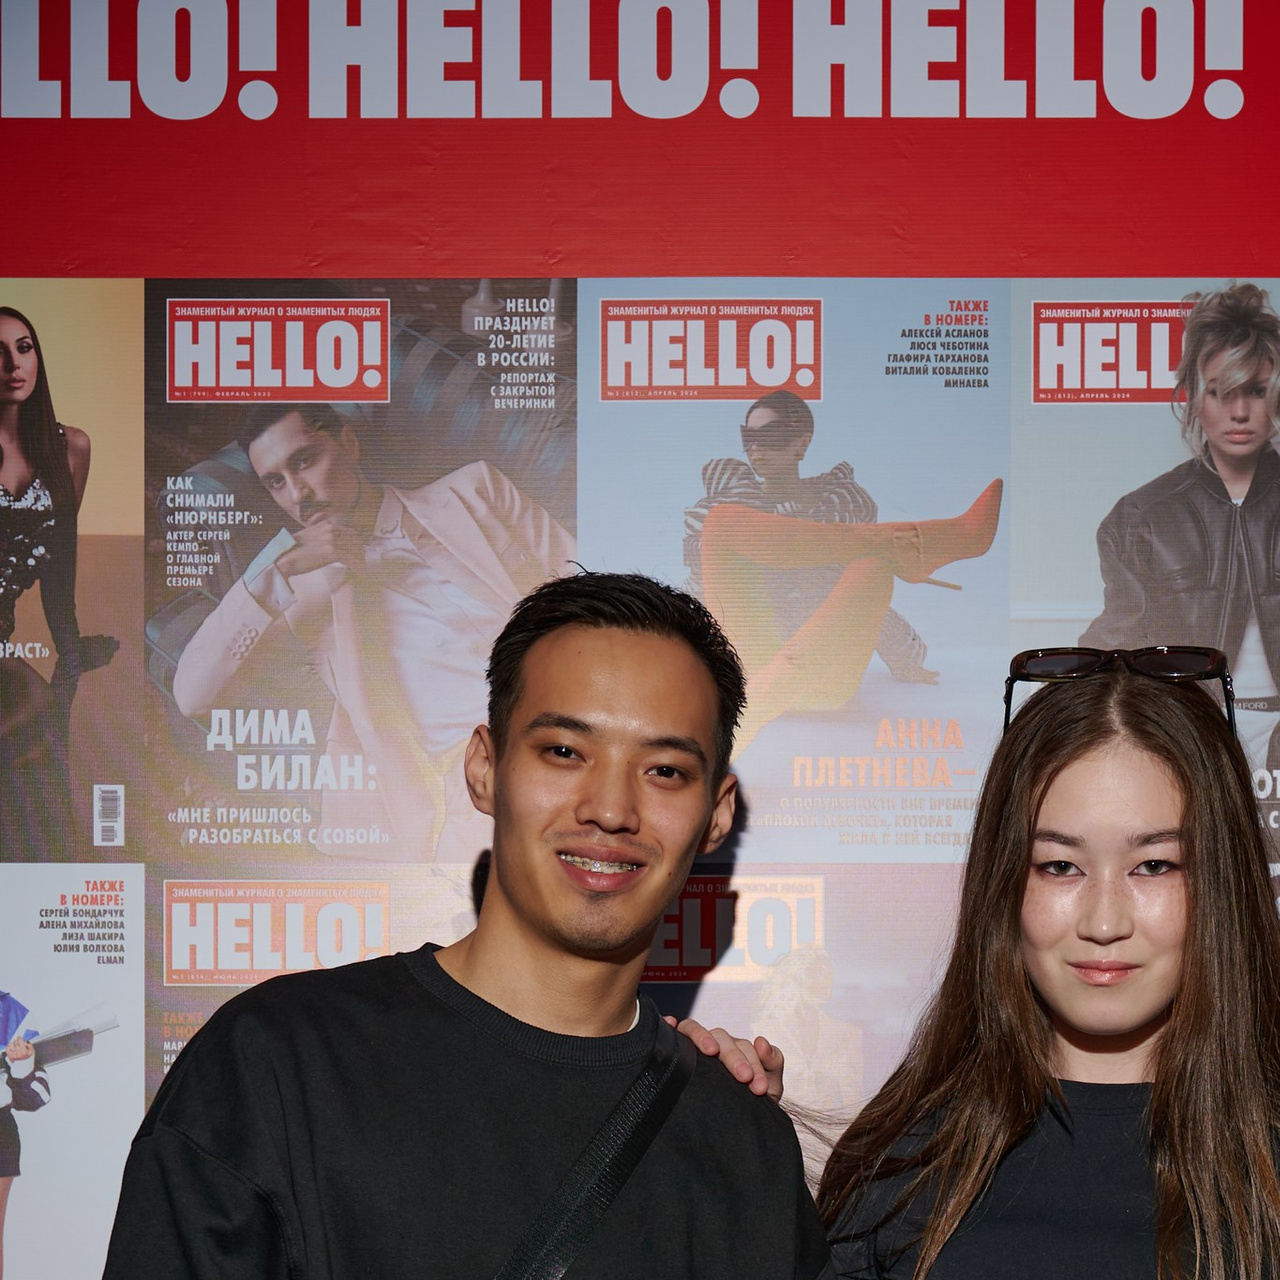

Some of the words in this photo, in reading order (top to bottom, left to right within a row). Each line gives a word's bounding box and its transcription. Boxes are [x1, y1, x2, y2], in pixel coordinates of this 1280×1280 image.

[308, 0, 762, 120] HELLO!
[792, 0, 1245, 120] HELLO!
[175, 305, 236, 317] ЗНАМЕНИТЫЙ
[237, 307, 276, 317] ЖУРНАЛ
[286, 306, 346, 317] ЗНАМЕНИТЫХ
[348, 306, 381, 318] ЛЮДЯХ
[506, 298, 555, 312] HELLO!
[949, 300, 989, 312] ТАКЖЕ
[1040, 307, 1101, 318] ЗНАМЕНИТЫЙ
[1102, 308, 1141, 318] ЖУРНАЛ
[1151, 308, 1193, 318] ЗНАМЕНИ
[474, 317, 555, 333] ПРАЗДНУЕТ
[900, 327, 943, 338] АЛЕКСЕЙ
[945, 328, 989, 338] АСЛАНОВ
[488, 335, 555, 348] 20-ЛЕТИЕ
[910, 341, 938, 351] ЛЮСЯ
[940, 341, 989, 351] ЧЕБОТИНА
[174, 320, 382, 388] HELLO!
[477, 353, 486, 366] В
[491, 353, 555, 366] РОССИИ:
[607, 319, 815, 387] HELLO!
[887, 353, 932, 363] ГЛАФИРА
[934, 353, 989, 363] ТАРХАНОВА
[885, 365, 929, 376] ВИТАЛИЙ
[932, 366, 989, 376] КОВАЛЕНКО
[500, 373, 555, 384] РЕПОРТАЖ
[944, 379, 989, 388] МИНАЕВА
[494, 398, 555, 409] ВЕЧЕРИНКИ
[166, 477, 193, 490] КАК
[166, 494, 235, 507] СНИМАЛИ
[166, 511, 263, 525] «НЮРНБЕРГ»:
[166, 531, 195, 541] АКТЕР
[198, 529, 230, 541] СЕРГЕЙ
[166, 543, 199, 552] КЕМПО
[166, 565, 213, 575] ПРЕМЬЕРЕ
[166, 577, 202, 587] СЕЗОНА
[206, 709, 315, 751] ДИМА
[874, 718, 964, 749] АННА
[236, 754, 377, 790] БИЛАН:
[168, 807, 210, 823] «МНЕ
[216, 807, 311, 823] ПРИШЛОСЬ
[189, 828, 301, 844] РАЗОБРАТЬСЯ
[323, 826, 390, 844] СОБОЙ»
[39, 907, 70, 918] СЕРГЕЙ
[72, 908, 125, 920] БОНДАРЧУК
[39, 920, 68, 929] АЛЕНА
[70, 918, 125, 929] МИХАЙЛОВА
[61, 931, 85, 941] ЛИЗА
[87, 931, 125, 941] ШАКИРА
[171, 902, 383, 970] HELLO!
[53, 943, 80, 953] ЮЛИЯ
[83, 943, 125, 953] ВОЛКОВА
[97, 955, 125, 965] ELMAN
